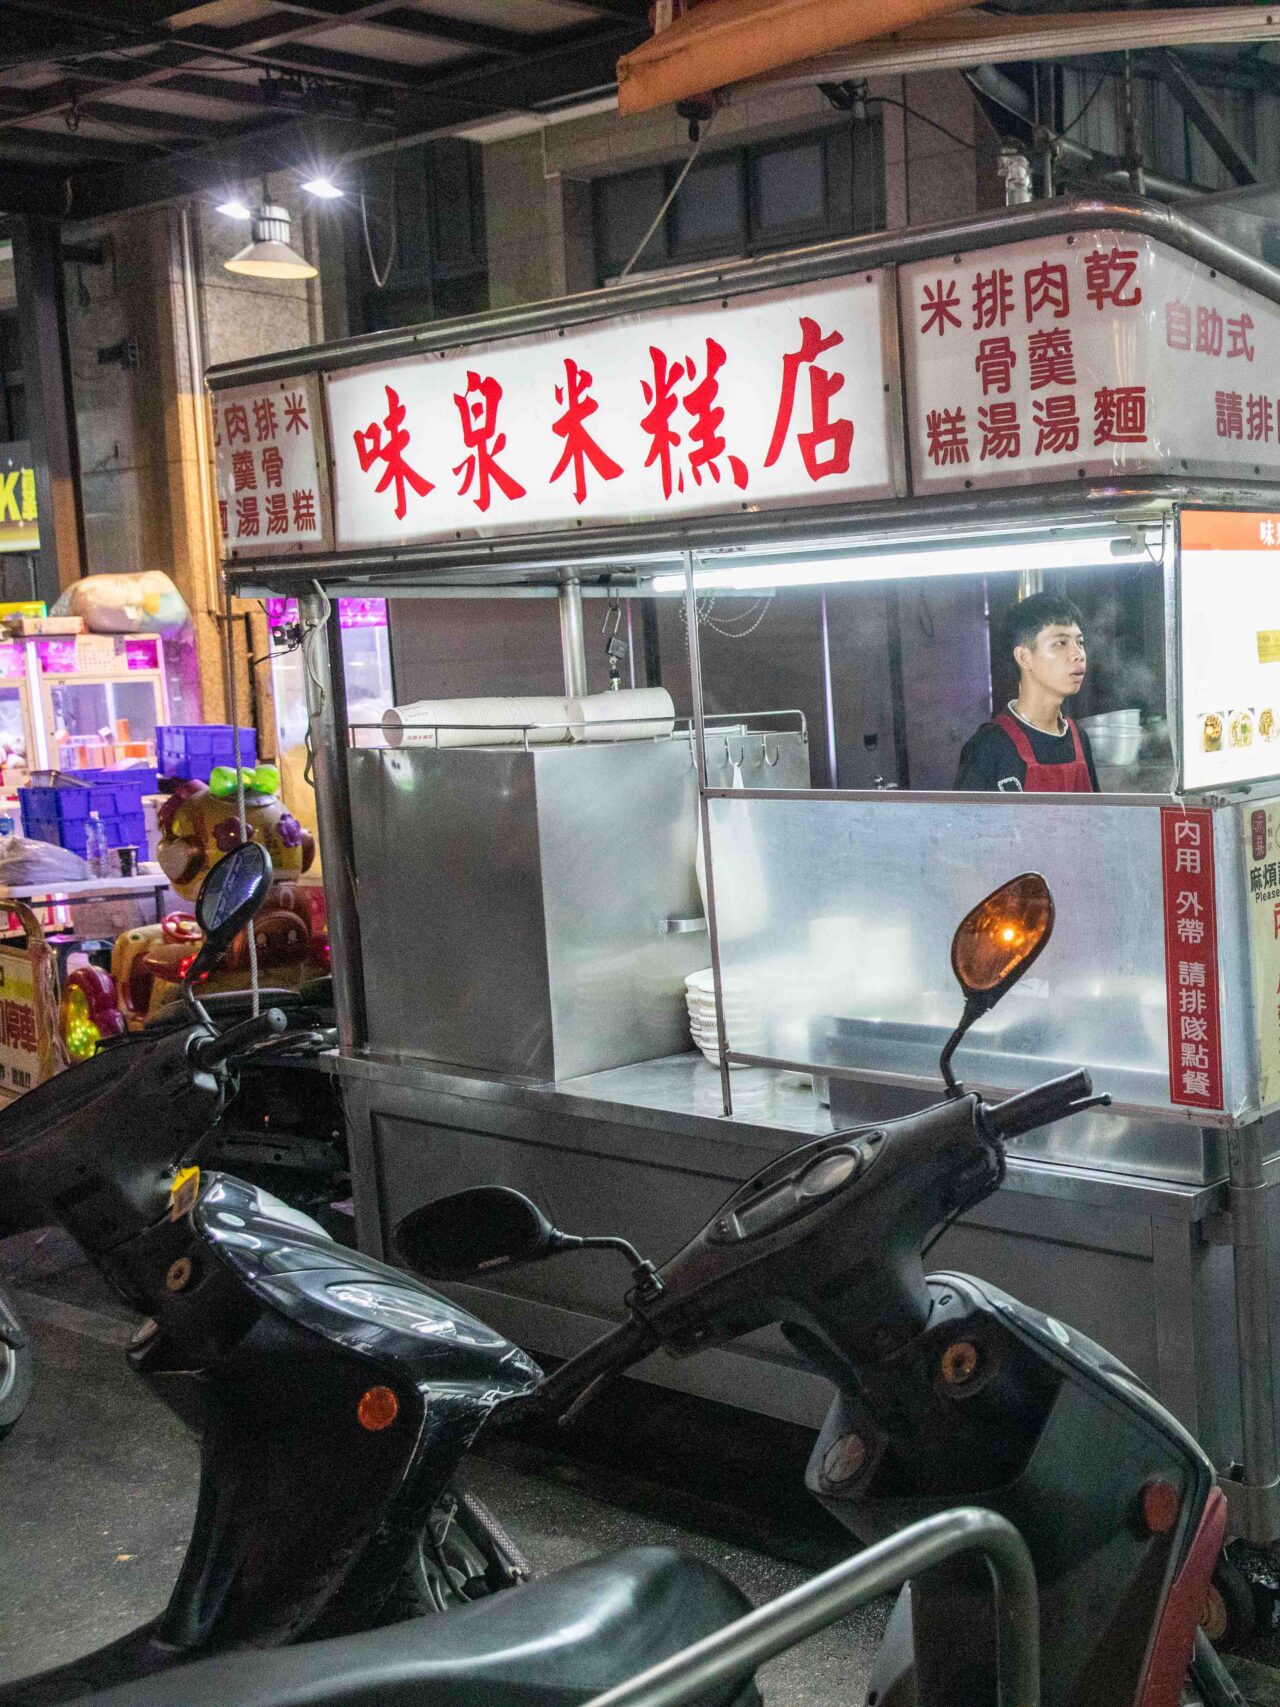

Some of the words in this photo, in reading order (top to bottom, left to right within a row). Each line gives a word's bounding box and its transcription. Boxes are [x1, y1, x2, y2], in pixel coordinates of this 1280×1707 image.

[972, 268, 1021, 461] 排骨湯
[1024, 260, 1080, 456] 肉羹湯
[1165, 299, 1255, 362] 自助式
[224, 403, 260, 538] 肉羹湯
[253, 398, 288, 536] 排骨湯
[354, 316, 855, 522] 味泉米糕店
[1176, 891, 1204, 944] 外帶
[1255, 888, 1280, 903] Please
[1178, 960, 1210, 1097] 請排隊點餐
